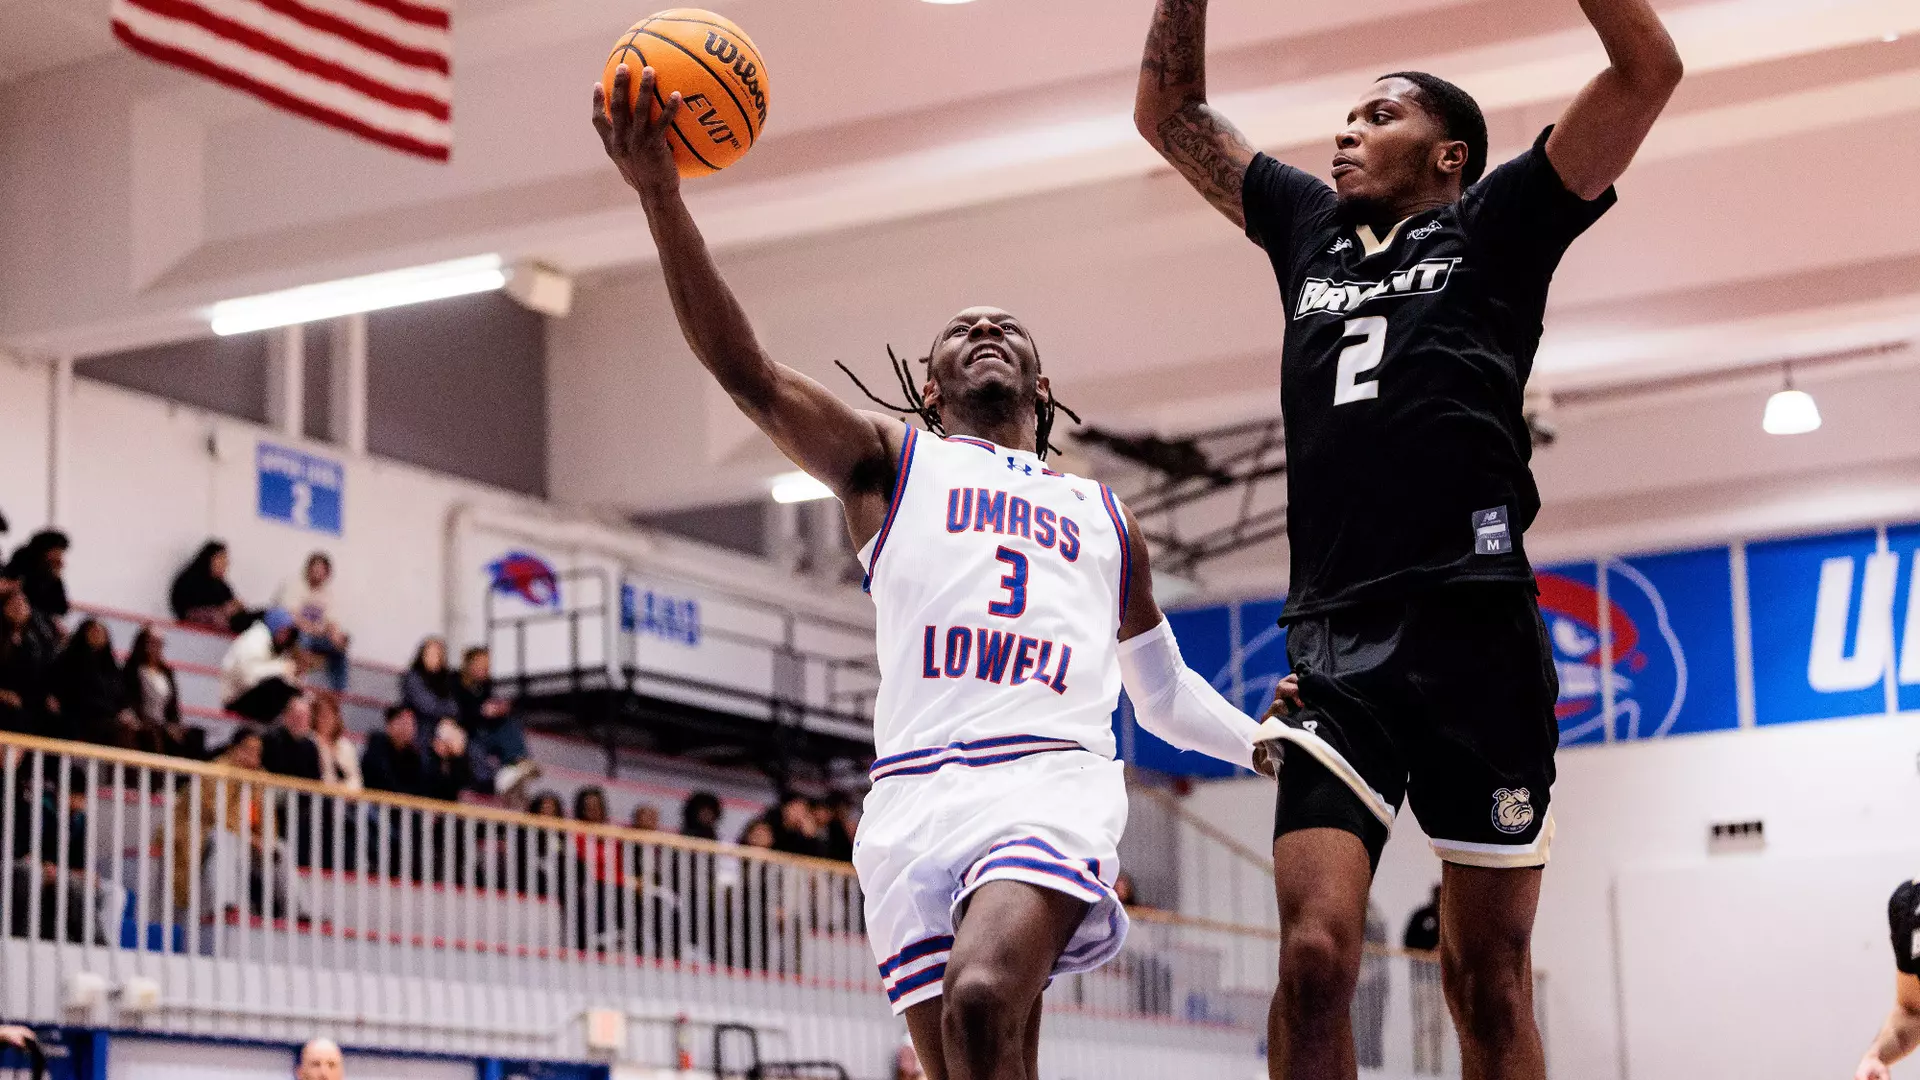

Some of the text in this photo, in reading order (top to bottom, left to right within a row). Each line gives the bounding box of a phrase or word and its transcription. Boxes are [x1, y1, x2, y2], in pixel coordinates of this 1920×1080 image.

[704, 31, 767, 129] Wilson
[683, 93, 734, 144] EVO
[1333, 315, 1388, 406] 2
[946, 487, 1081, 562] UMASS
[1486, 539, 1500, 551] M
[988, 545, 1029, 618] 3
[1808, 546, 1920, 693] U
[923, 625, 1072, 695] LOWELL
